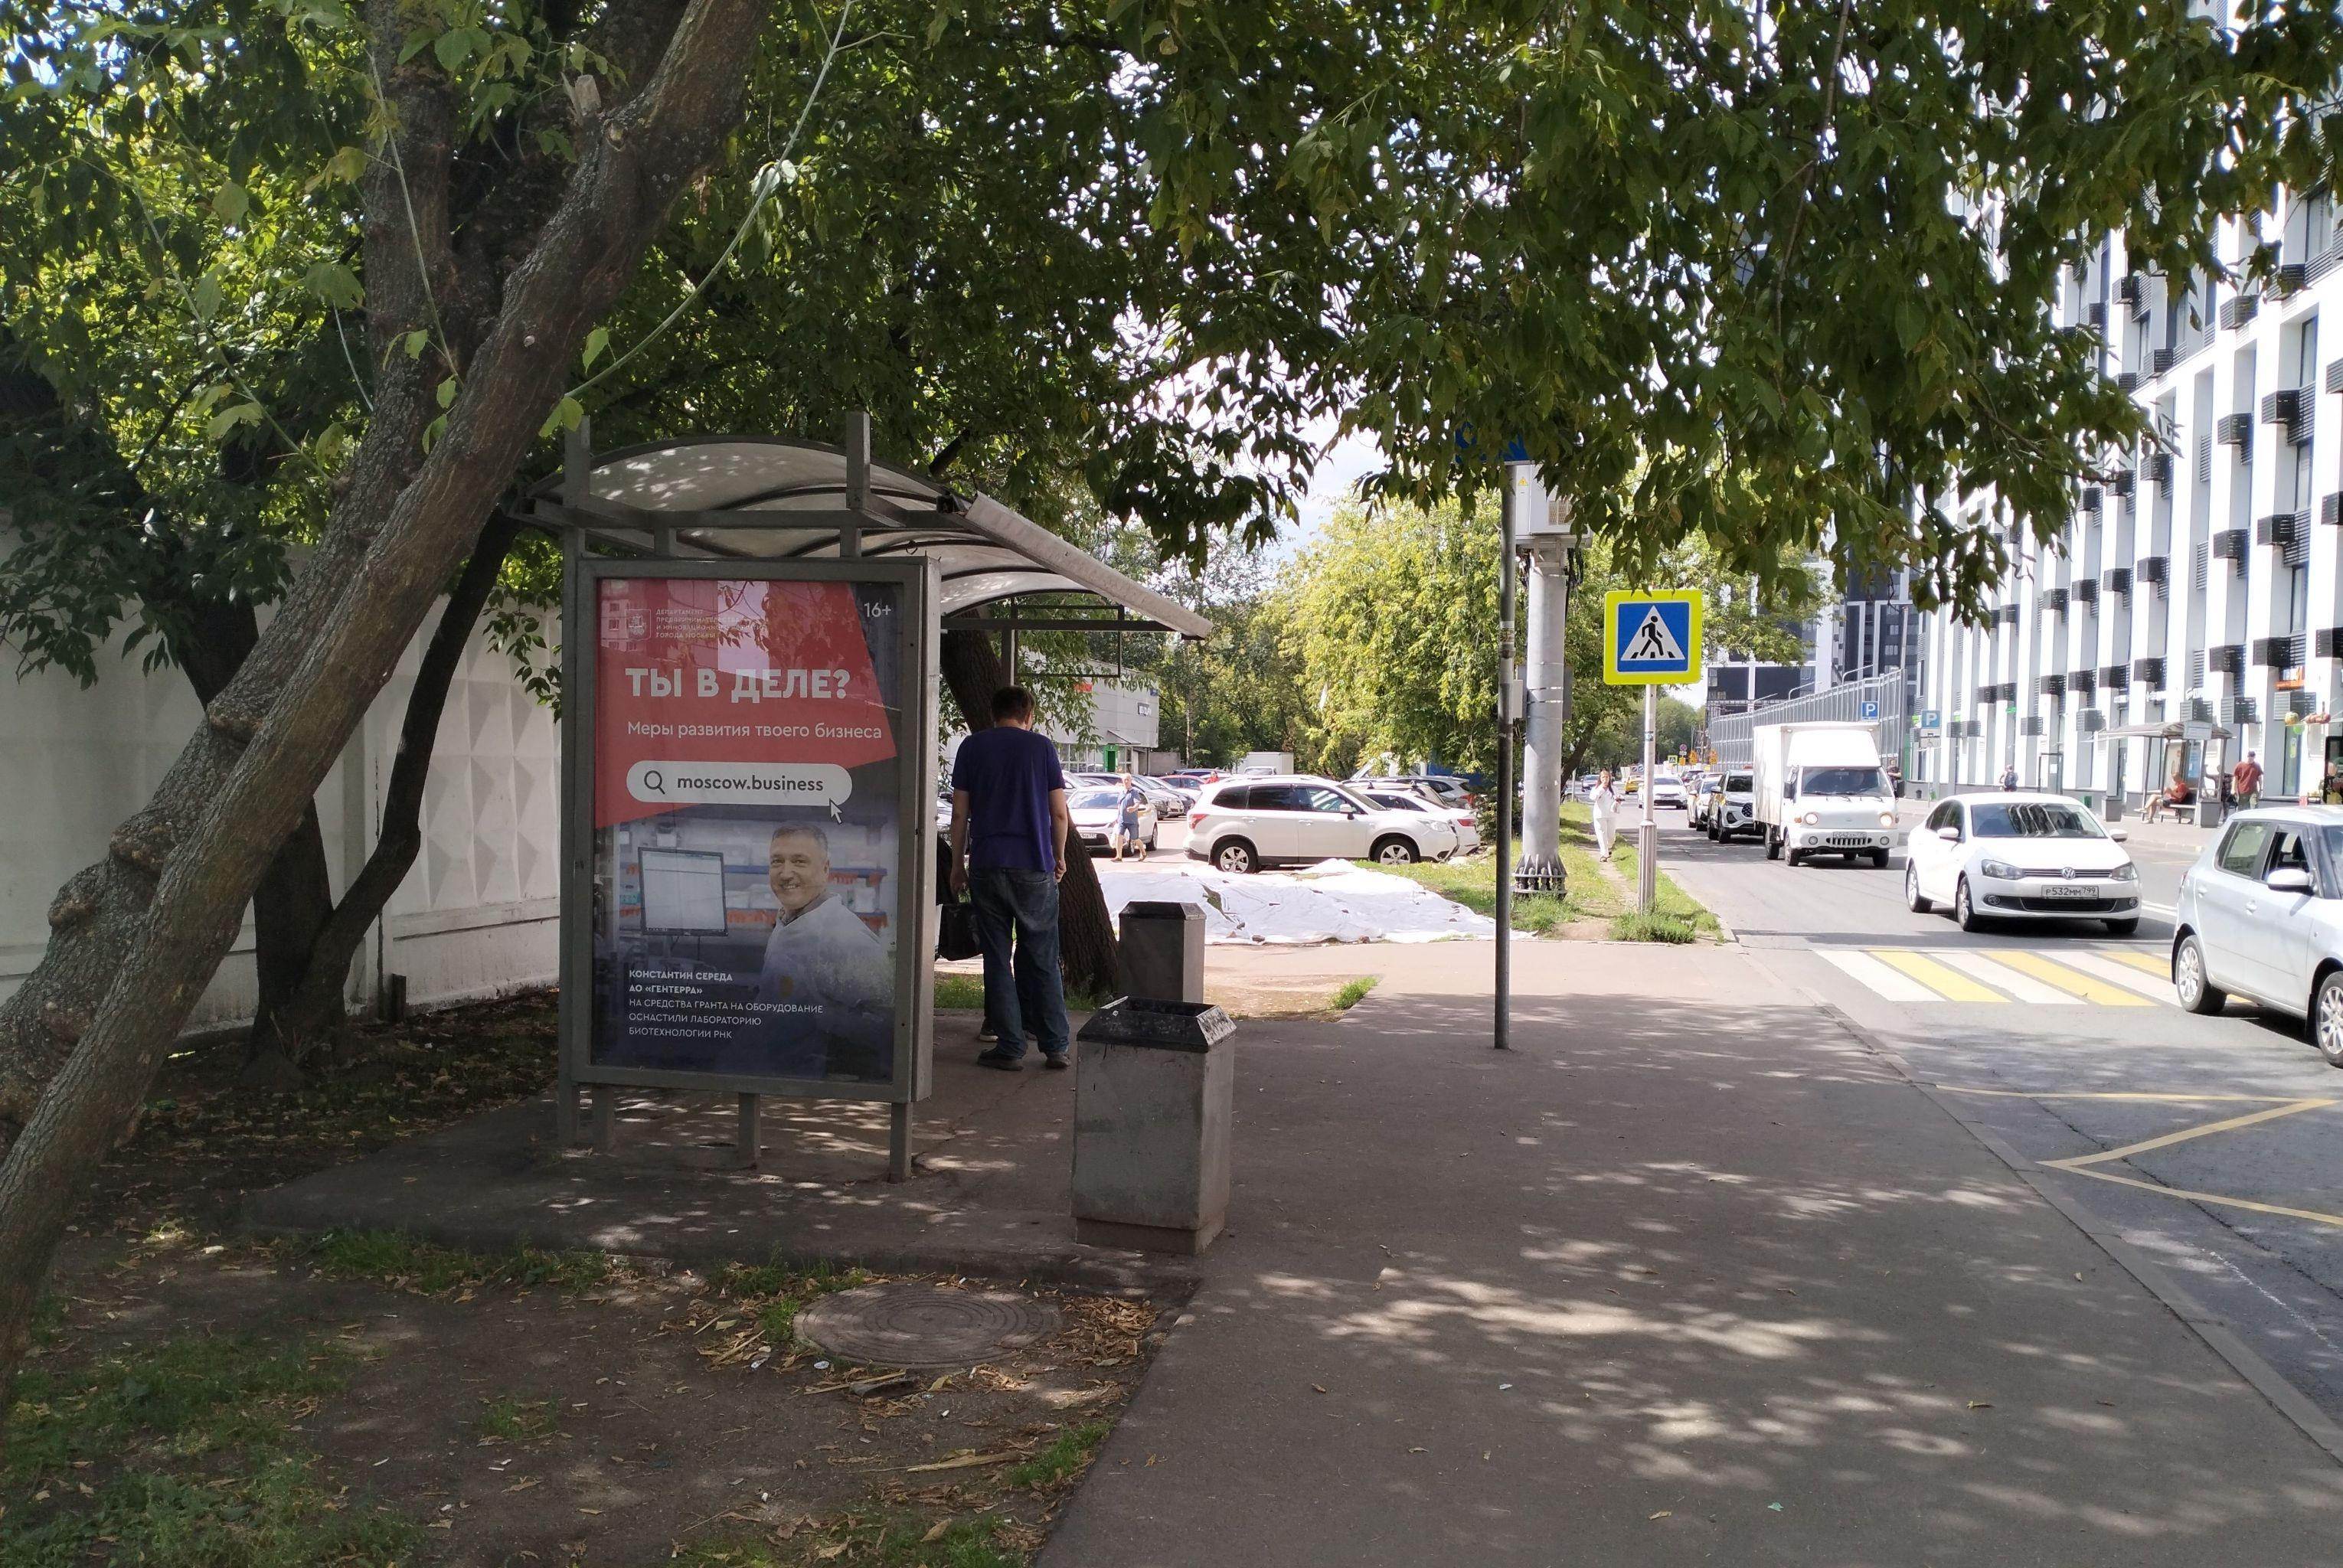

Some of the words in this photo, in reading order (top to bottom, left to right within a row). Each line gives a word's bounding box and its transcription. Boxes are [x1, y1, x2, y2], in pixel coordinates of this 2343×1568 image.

[864, 602, 891, 617] 16+
[625, 668, 681, 697] ТЫ
[698, 668, 719, 697] В
[731, 668, 850, 704] ДЕЛЕ?
[1866, 704, 1876, 716] P
[1926, 712, 1937, 726] P
[627, 721, 673, 738] Меры
[678, 724, 750, 738] развития
[755, 724, 810, 737] твоего
[815, 722, 882, 739] бизнеса
[677, 775, 824, 791] moscow.business
[629, 970, 693, 980] КОНСТАНТИН
[695, 972, 733, 982] СЕРЕДА
[629, 984, 642, 992] АО
[645, 985, 703, 995] «ГЕНТЕРРА»
[629, 998, 642, 1007] НА
[644, 998, 692, 1009] СРЕДСТВА
[694, 1001, 728, 1010] ГРАНТА
[730, 1002, 743, 1011] НА
[745, 1002, 824, 1014] ОБОРУДОВАНИЕ
[629, 1013, 688, 1023] ОСНАСТИЛИ
[691, 1015, 762, 1026] ЛАБОРАТОРИЮ
[629, 1027, 711, 1037] БИОТЕХНОЛОГИИ
[714, 1031, 733, 1039] РНК
